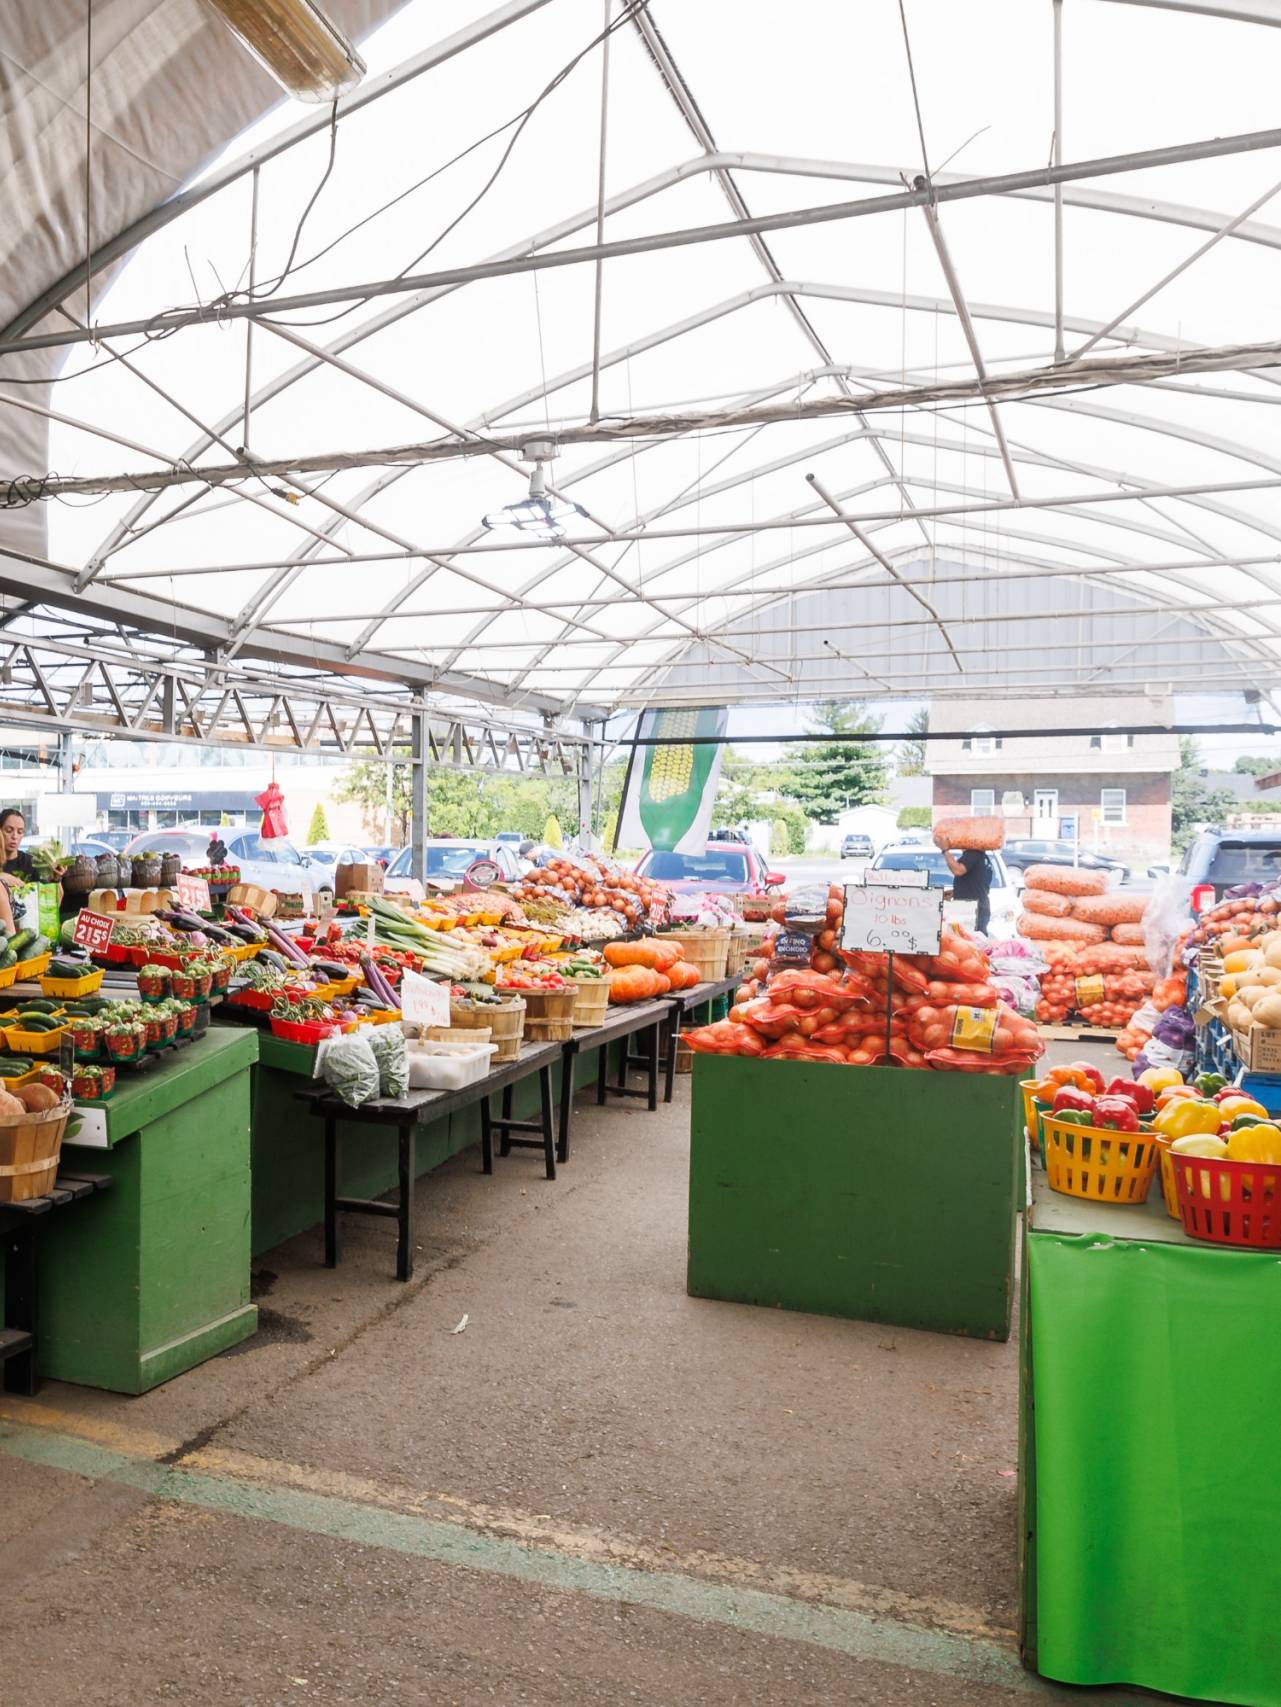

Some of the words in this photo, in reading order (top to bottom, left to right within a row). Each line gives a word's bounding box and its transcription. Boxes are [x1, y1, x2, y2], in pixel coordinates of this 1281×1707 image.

[851, 889, 933, 911] Oignons
[81, 915, 90, 923] AU
[90, 918, 110, 930] CHOIX
[874, 916, 888, 924] 10
[891, 915, 906, 925] lbs
[76, 924, 86, 940] 2
